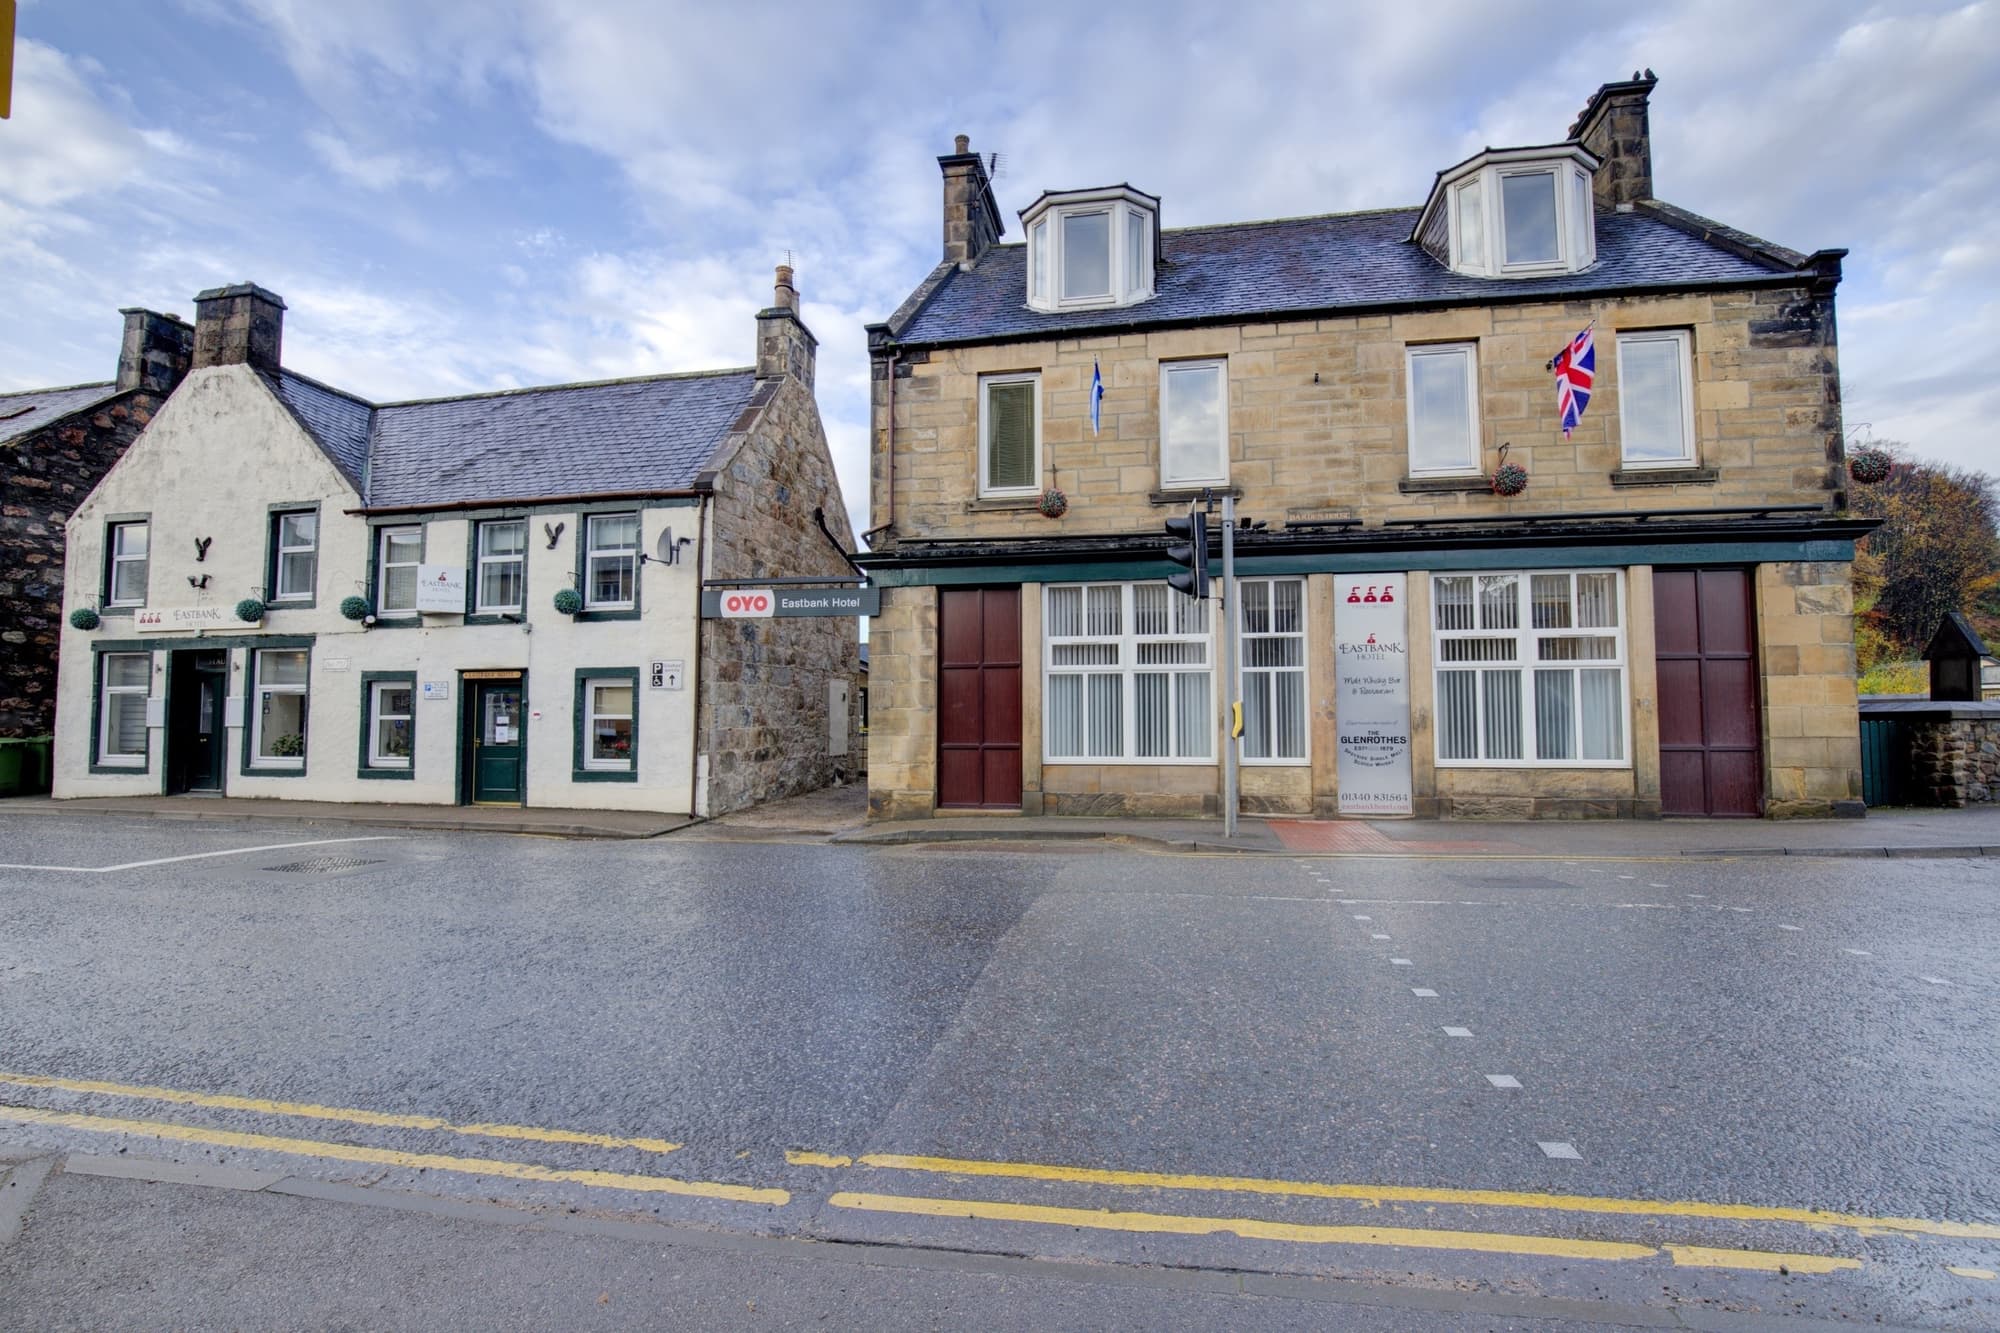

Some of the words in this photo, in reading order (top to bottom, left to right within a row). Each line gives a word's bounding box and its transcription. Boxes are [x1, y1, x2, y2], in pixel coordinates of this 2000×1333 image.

[727, 595, 768, 612] OYO
[781, 598, 828, 608] Eastbank
[832, 598, 860, 608] Hotel
[174, 608, 221, 621] EASTBANK
[1339, 642, 1405, 655] EASTBANK
[1340, 736, 1407, 745] GLENROTHES
[1341, 793, 1371, 801] 01340
